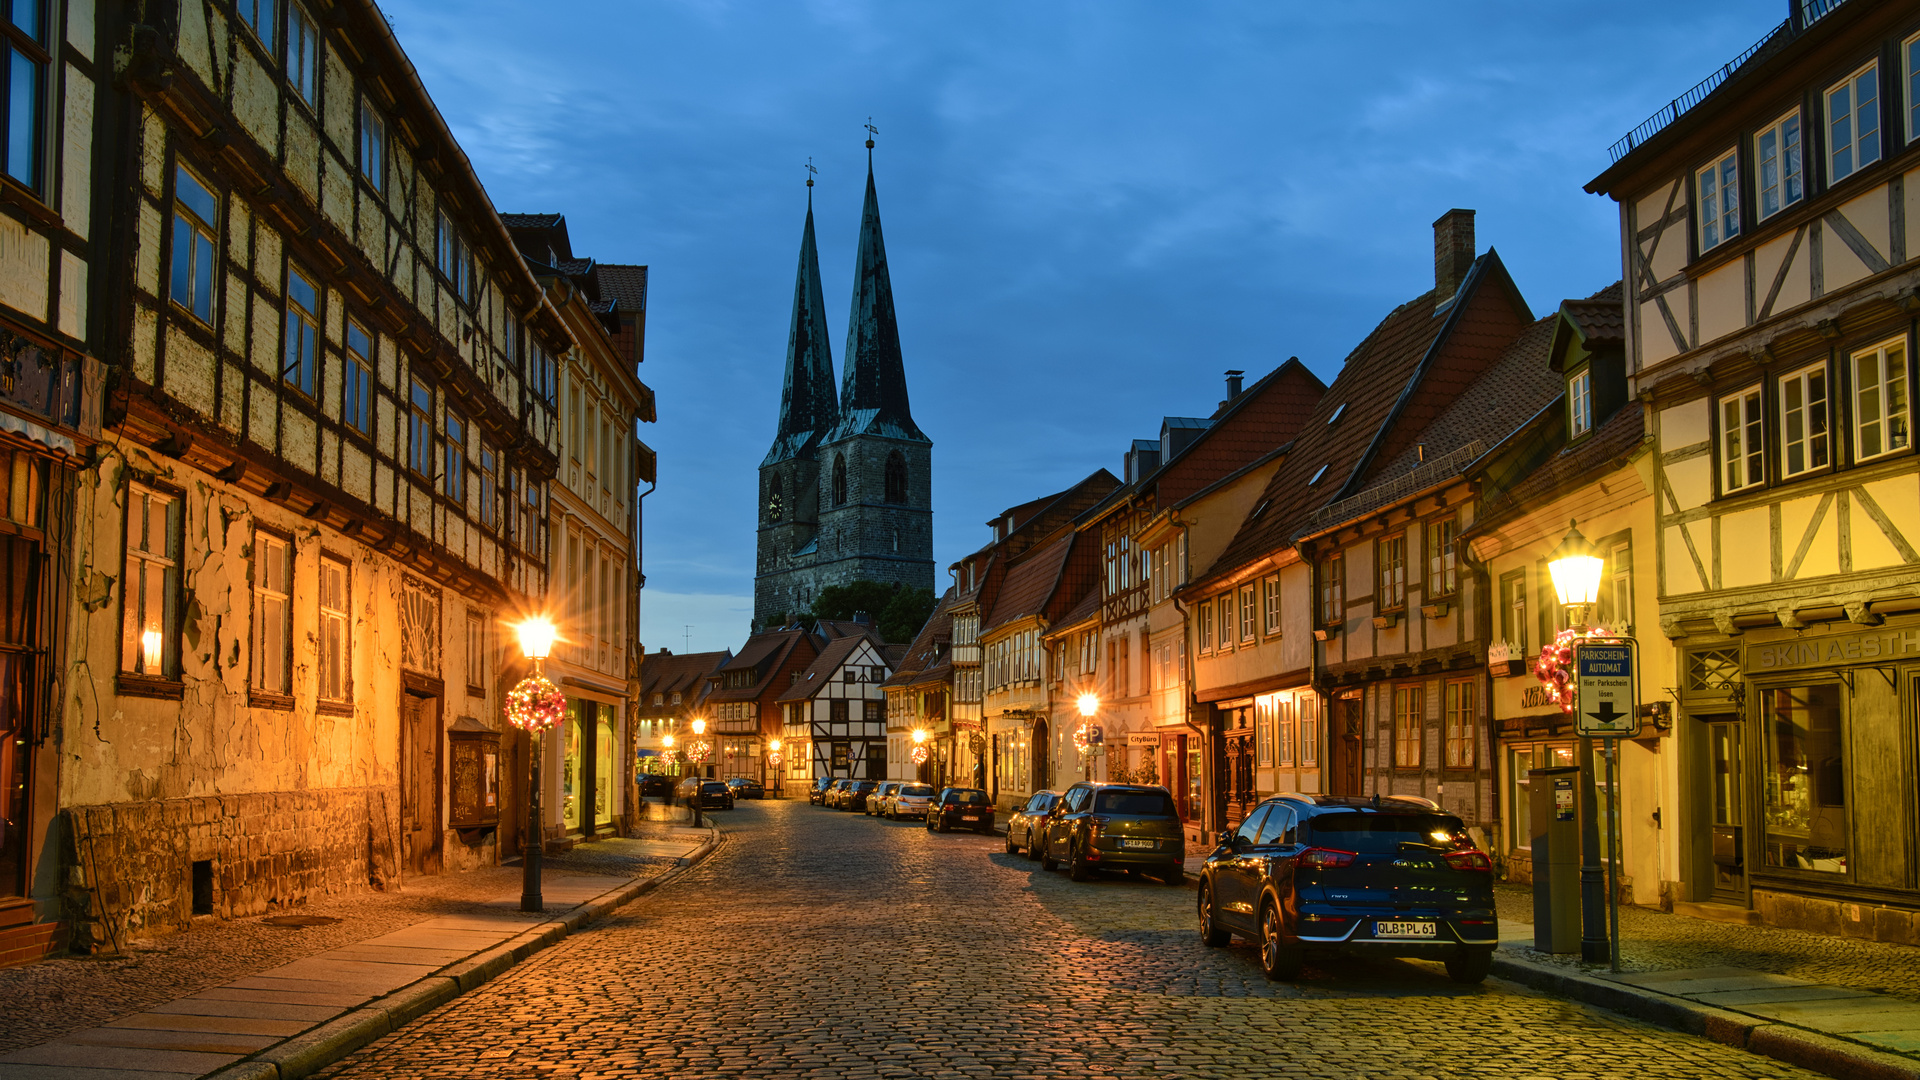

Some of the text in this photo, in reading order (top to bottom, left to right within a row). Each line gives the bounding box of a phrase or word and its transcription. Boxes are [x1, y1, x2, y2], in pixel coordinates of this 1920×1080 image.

[1761, 630, 1920, 668] SKIN AESTH
[1580, 650, 1629, 661] PARKSCHEIN-
[1588, 663, 1622, 673] AUTOMAT
[1583, 679, 1628, 687] Hier Parkschein
[1598, 689, 1614, 698] lösen
[1089, 728, 1099, 742] P
[1130, 735, 1157, 744] CityBüro
[1378, 922, 1399, 934] QLB
[1406, 923, 1420, 934] PL
[1422, 922, 1435, 935] 61
